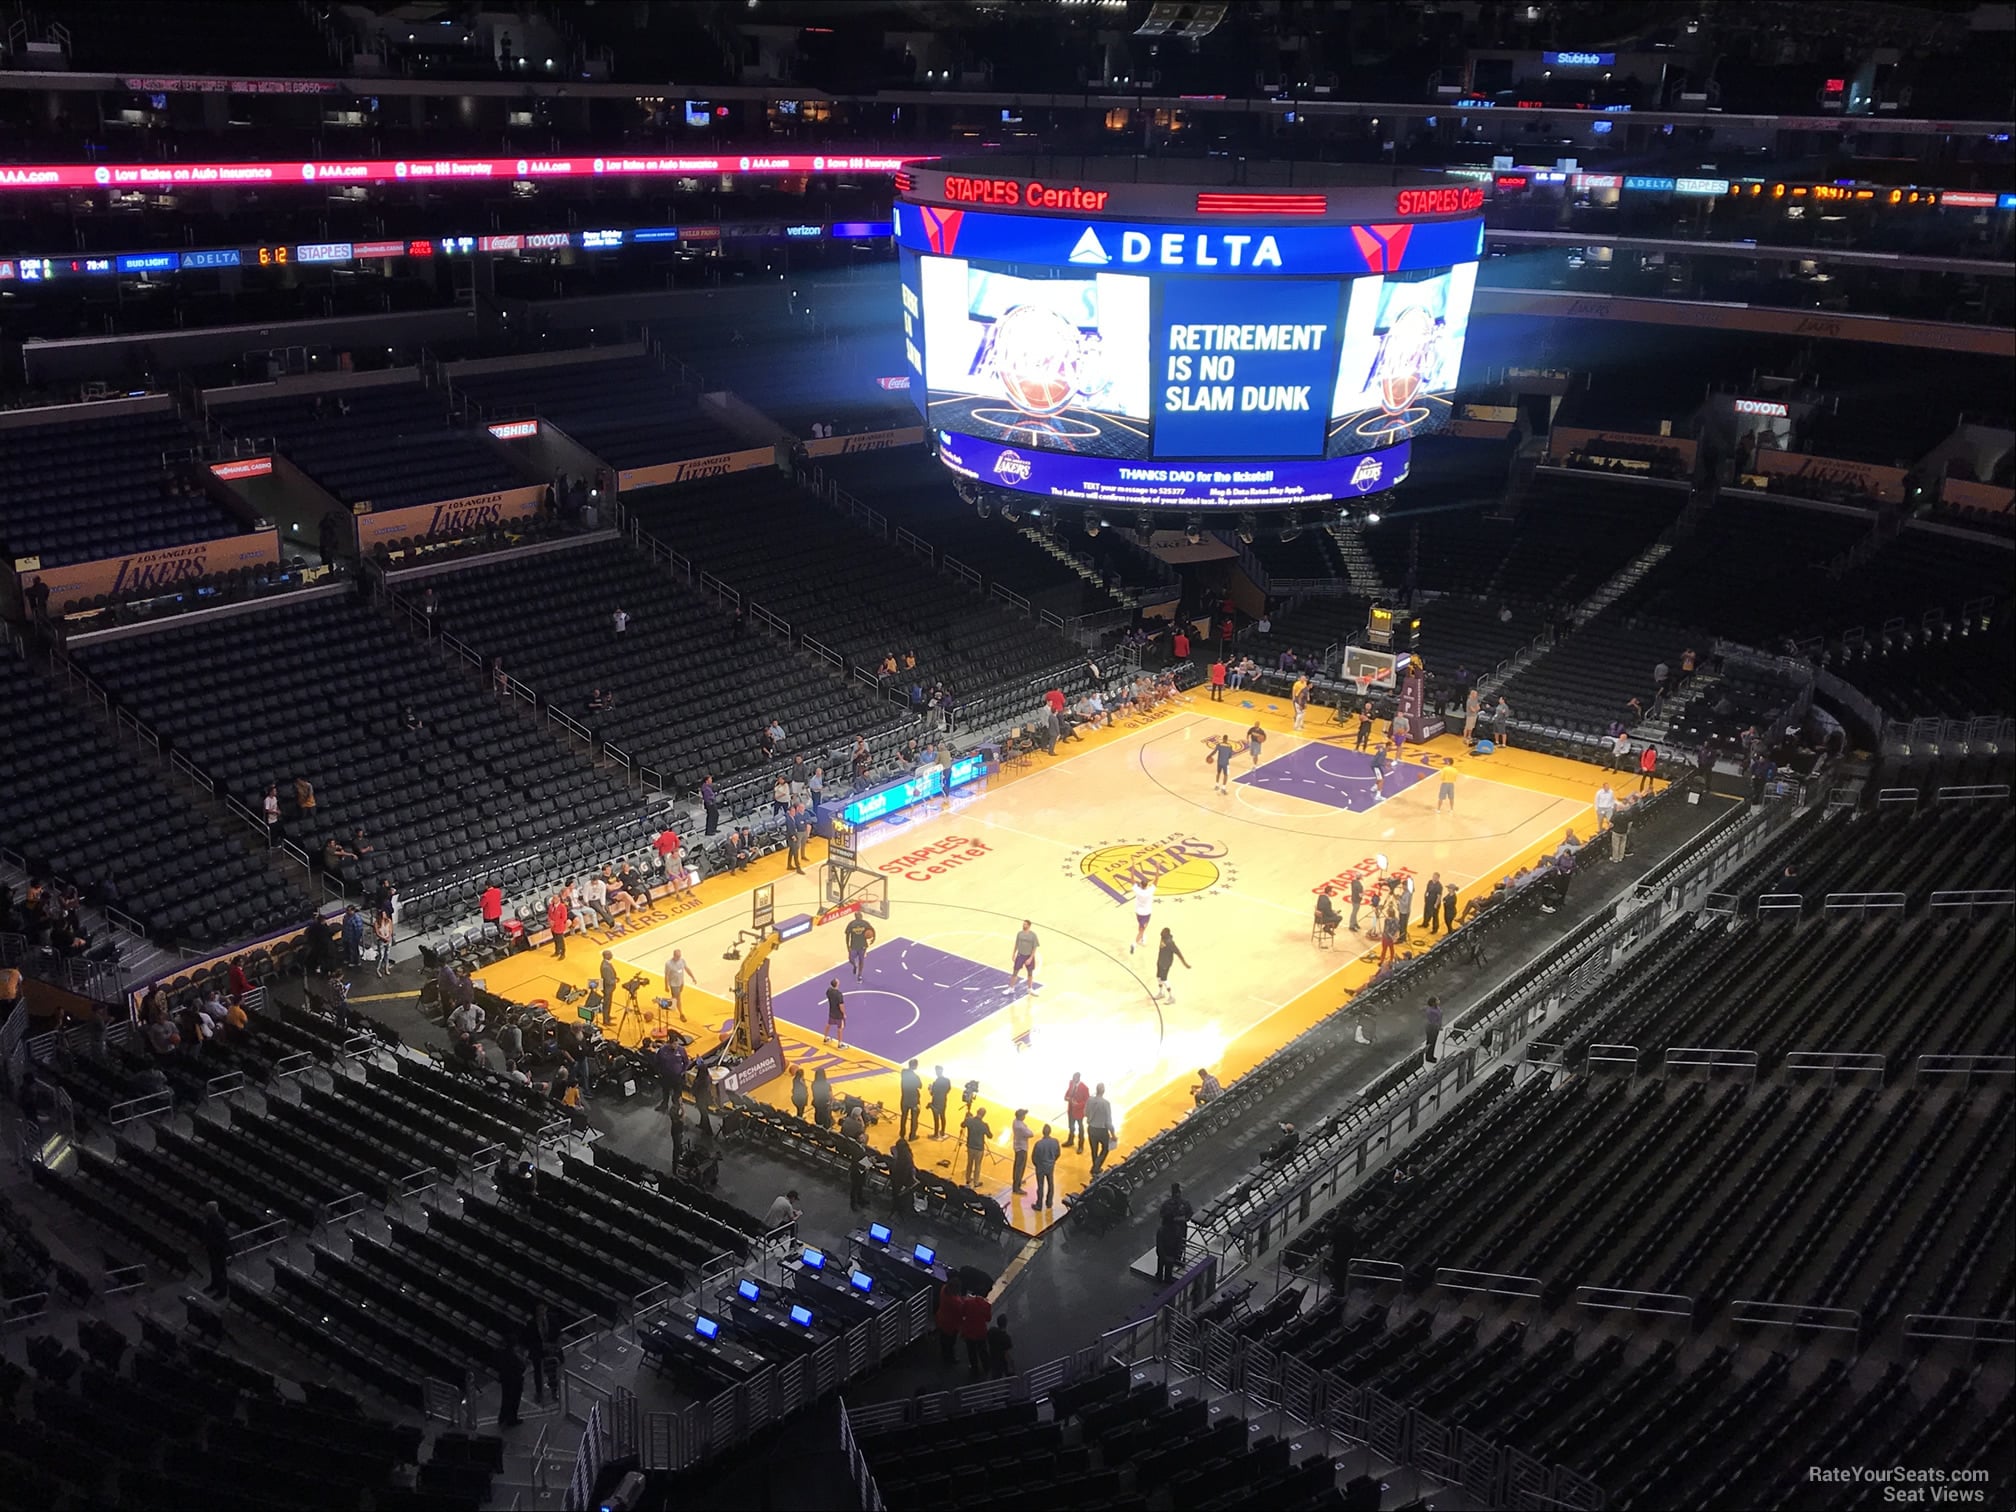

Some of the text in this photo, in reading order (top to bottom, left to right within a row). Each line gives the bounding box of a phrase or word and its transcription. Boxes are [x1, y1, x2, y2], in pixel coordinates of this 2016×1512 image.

[1558, 53, 1600, 65] StubHub
[319, 165, 368, 177] AAA.com
[531, 162, 571, 172] AAA.com
[752, 159, 789, 169] AAA.com
[0, 171, 59, 182] AAA.com
[115, 168, 272, 181] Low Rates on Auto Insurance
[1635, 179, 1674, 189] DELTA
[1678, 179, 1728, 193] STAPLES
[945, 177, 1108, 211] STAPLES Center
[1398, 189, 1459, 215] STAPLES
[786, 225, 821, 237] verizon
[526, 233, 570, 248] TOYOTA
[259, 246, 288, 265] 6:12
[299, 244, 351, 261] STAPLES
[1121, 231, 1283, 267] DELTA
[126, 258, 169, 268] BUD LIGHT
[196, 252, 239, 266] DELTA
[1169, 324, 1328, 351] RETIREMENT
[1167, 355, 1236, 381] IS NO
[1164, 386, 1312, 412] SLAM DUNK
[1736, 400, 1788, 416] TOYOTA
[1119, 468, 1168, 482] THANKS
[1169, 470, 1196, 483] DAD
[1196, 471, 1213, 483] for
[1213, 471, 1232, 483] the
[1051, 487, 1063, 495] The
[1063, 488, 1085, 498] Lakers
[1098, 493, 1126, 501] confirm
[1083, 481, 1100, 491] TEXT
[1100, 485, 1117, 493] your
[448, 495, 502, 511] LOS ANGELES
[427, 504, 502, 537] LAKERS
[137, 545, 207, 564] LOS ANGELES
[111, 555, 207, 593] LAKERS
[878, 836, 970, 873] STAPLES
[1104, 832, 1185, 873] LOS ANGELES
[905, 842, 993, 882] Center
[1080, 837, 1228, 907] LAKERS
[590, 898, 703, 945] LAKERS.COM
[739, 1057, 776, 1080] PECHANGA
